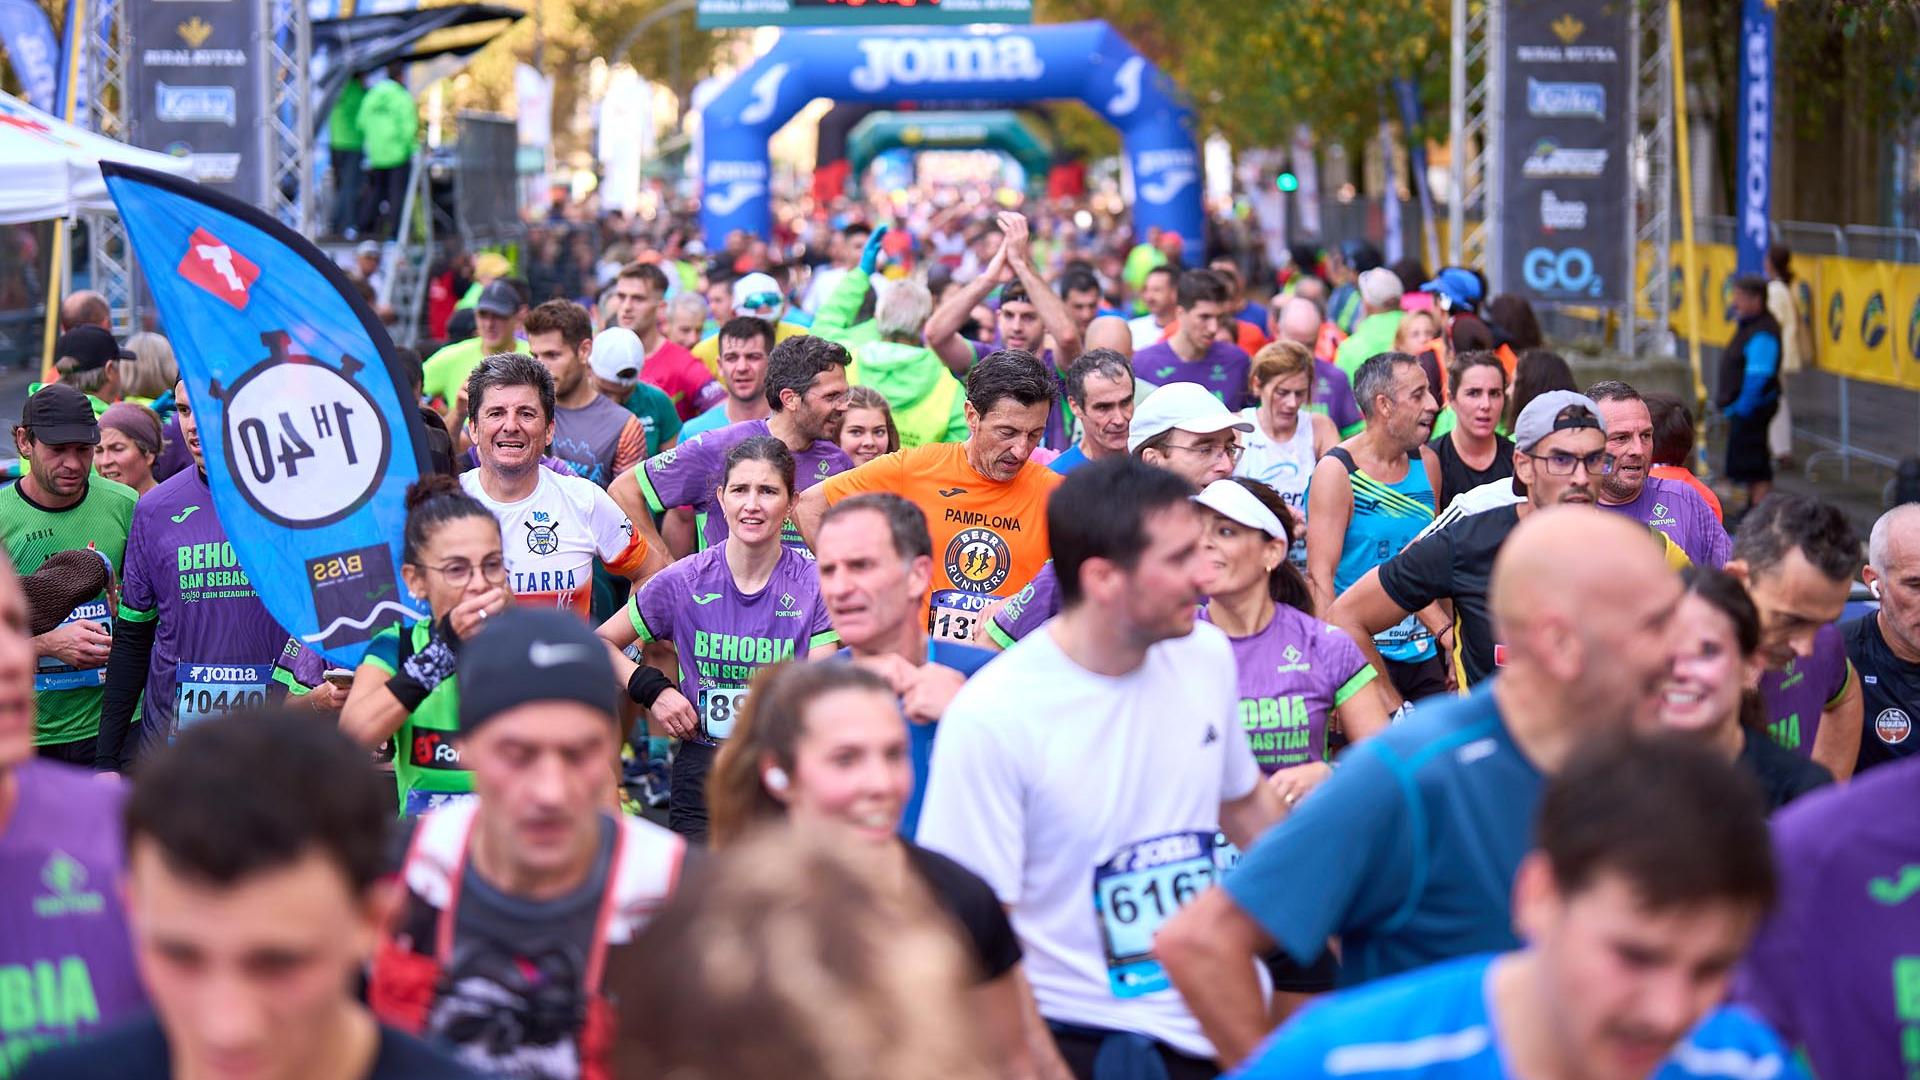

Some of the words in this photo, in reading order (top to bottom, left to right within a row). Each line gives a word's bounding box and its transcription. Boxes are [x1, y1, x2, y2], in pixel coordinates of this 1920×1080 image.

[944, 508, 1021, 532] PAMPLONA
[960, 530, 1000, 548] BEER
[178, 541, 242, 572] BEHO
[180, 573, 204, 589] SAN
[947, 563, 1007, 592] RUNNERS
[219, 590, 250, 598] DEZAGUN
[694, 629, 795, 664] BEHOBIA
